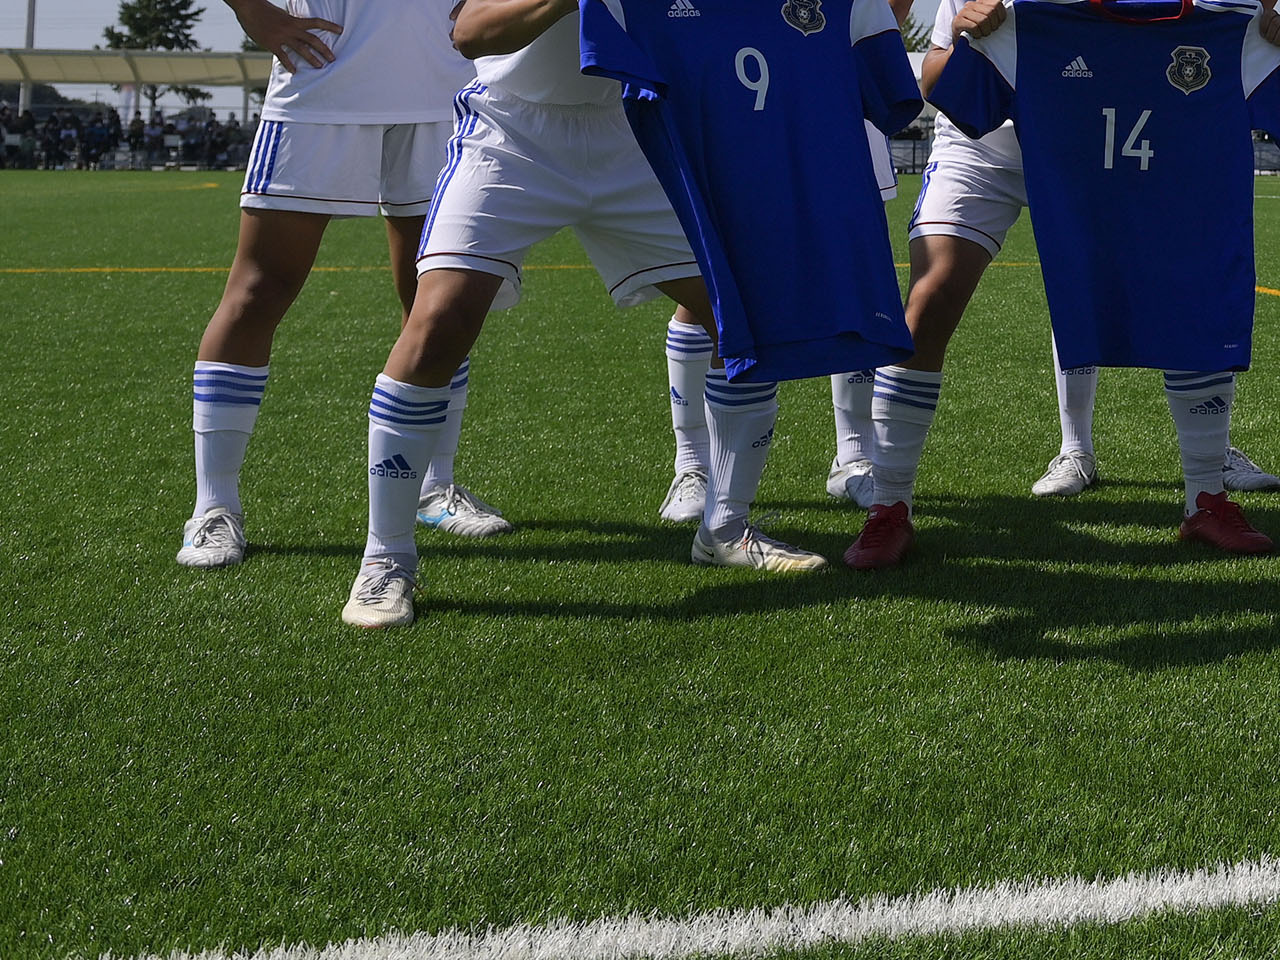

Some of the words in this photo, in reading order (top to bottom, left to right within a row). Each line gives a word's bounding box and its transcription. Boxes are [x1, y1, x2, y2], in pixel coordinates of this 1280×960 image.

[667, 8, 701, 18] adidas
[734, 46, 770, 111] 9
[1061, 69, 1094, 78] adidas
[1102, 108, 1154, 170] 14
[370, 467, 417, 479] adidas
